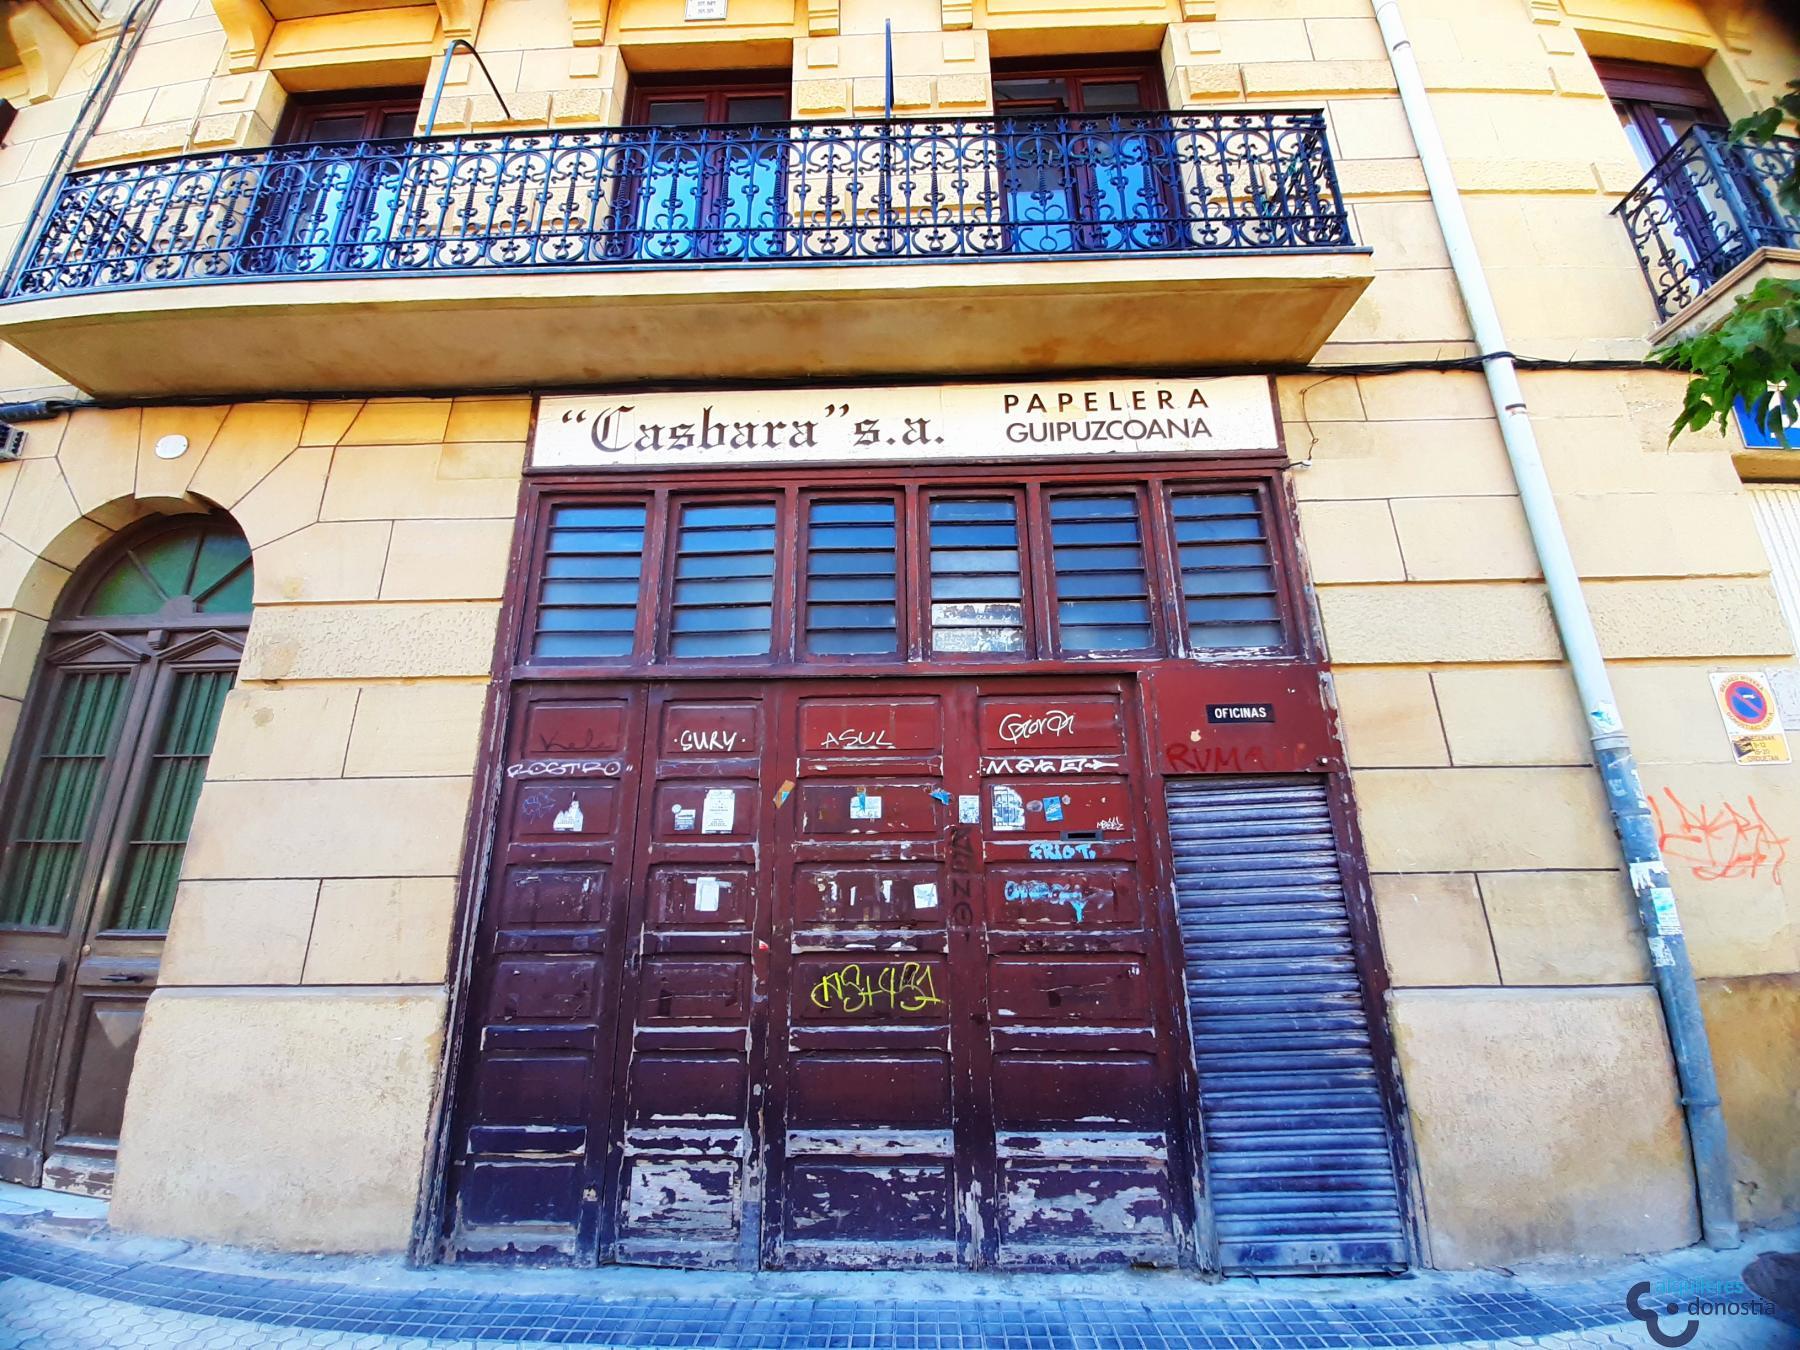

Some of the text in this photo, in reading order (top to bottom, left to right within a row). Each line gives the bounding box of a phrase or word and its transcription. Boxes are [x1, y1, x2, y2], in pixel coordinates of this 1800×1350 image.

[1004, 388, 1209, 413] PAPELERA
[853, 417, 945, 446] s.a.
[1006, 417, 1213, 443] GUIPUZCOANA
[1214, 707, 1267, 719] OFICINAS
